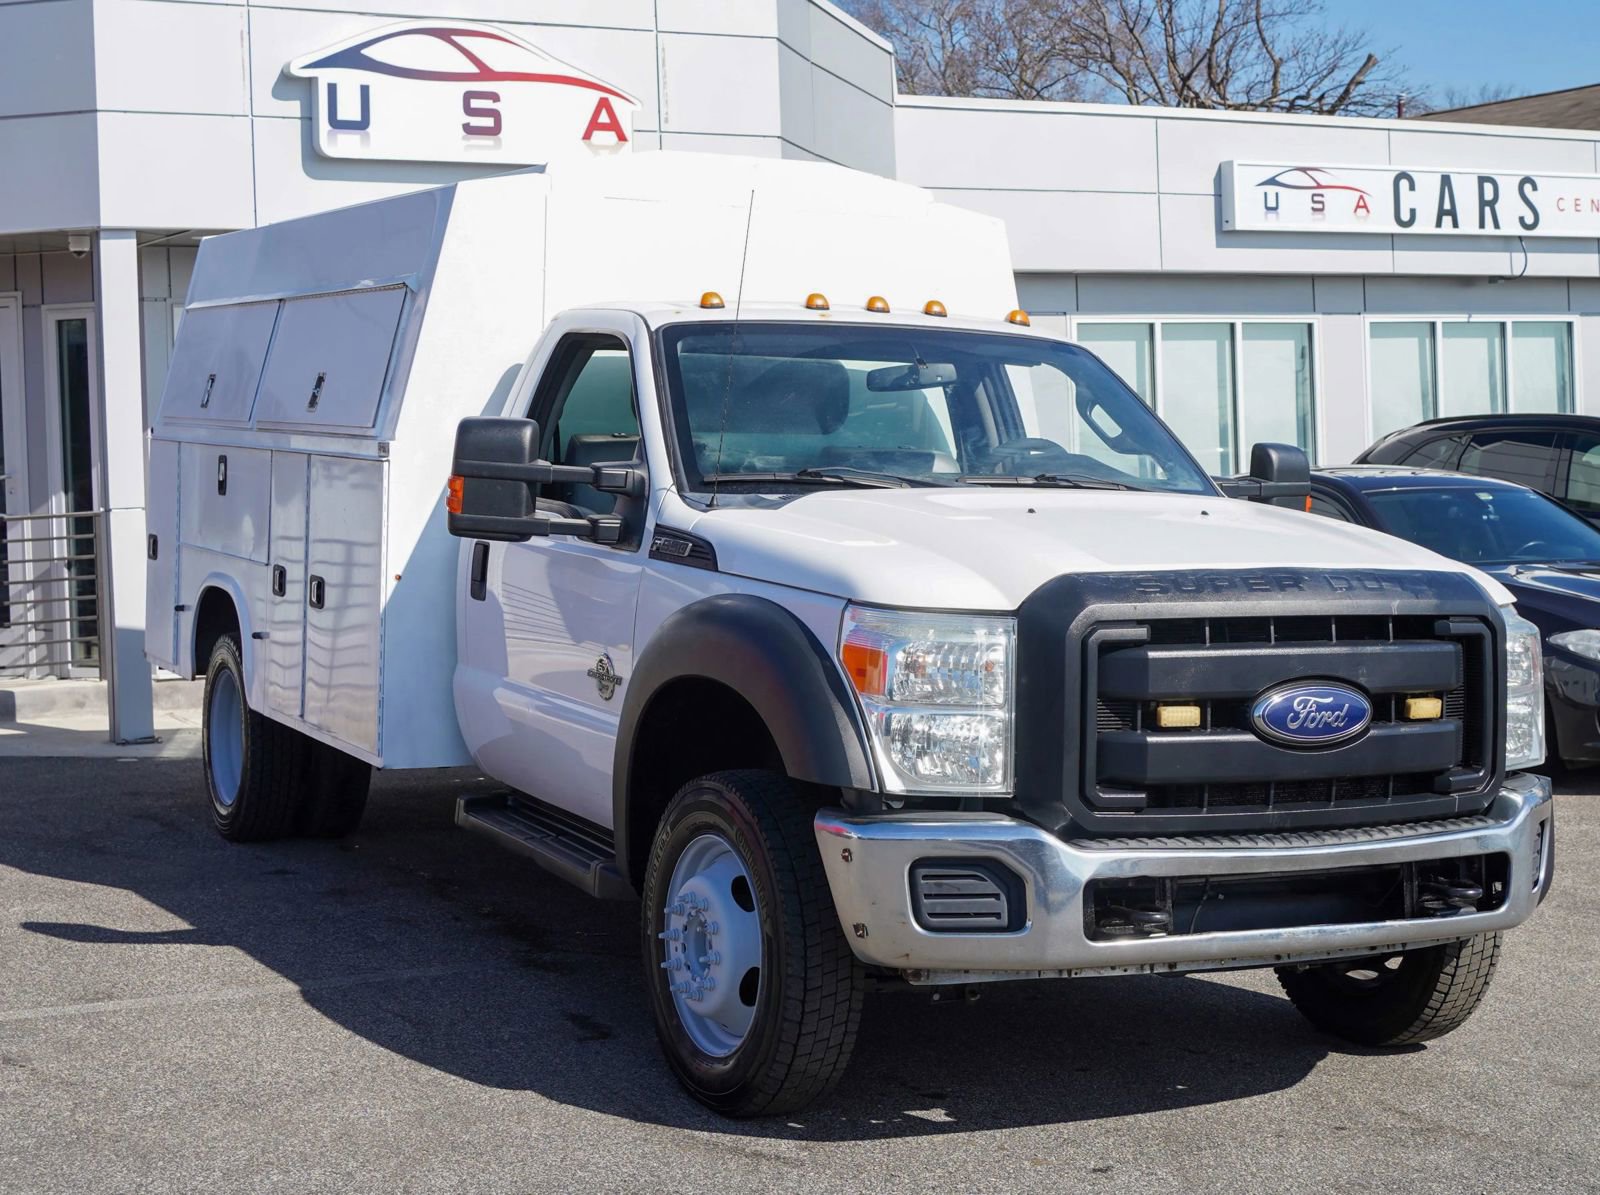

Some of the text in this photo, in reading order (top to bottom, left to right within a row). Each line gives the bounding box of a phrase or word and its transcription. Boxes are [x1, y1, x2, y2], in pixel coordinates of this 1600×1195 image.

[1392, 171, 1540, 231] CARS
[1134, 574, 1306, 594] SUPER
[1287, 696, 1349, 729] Ford
